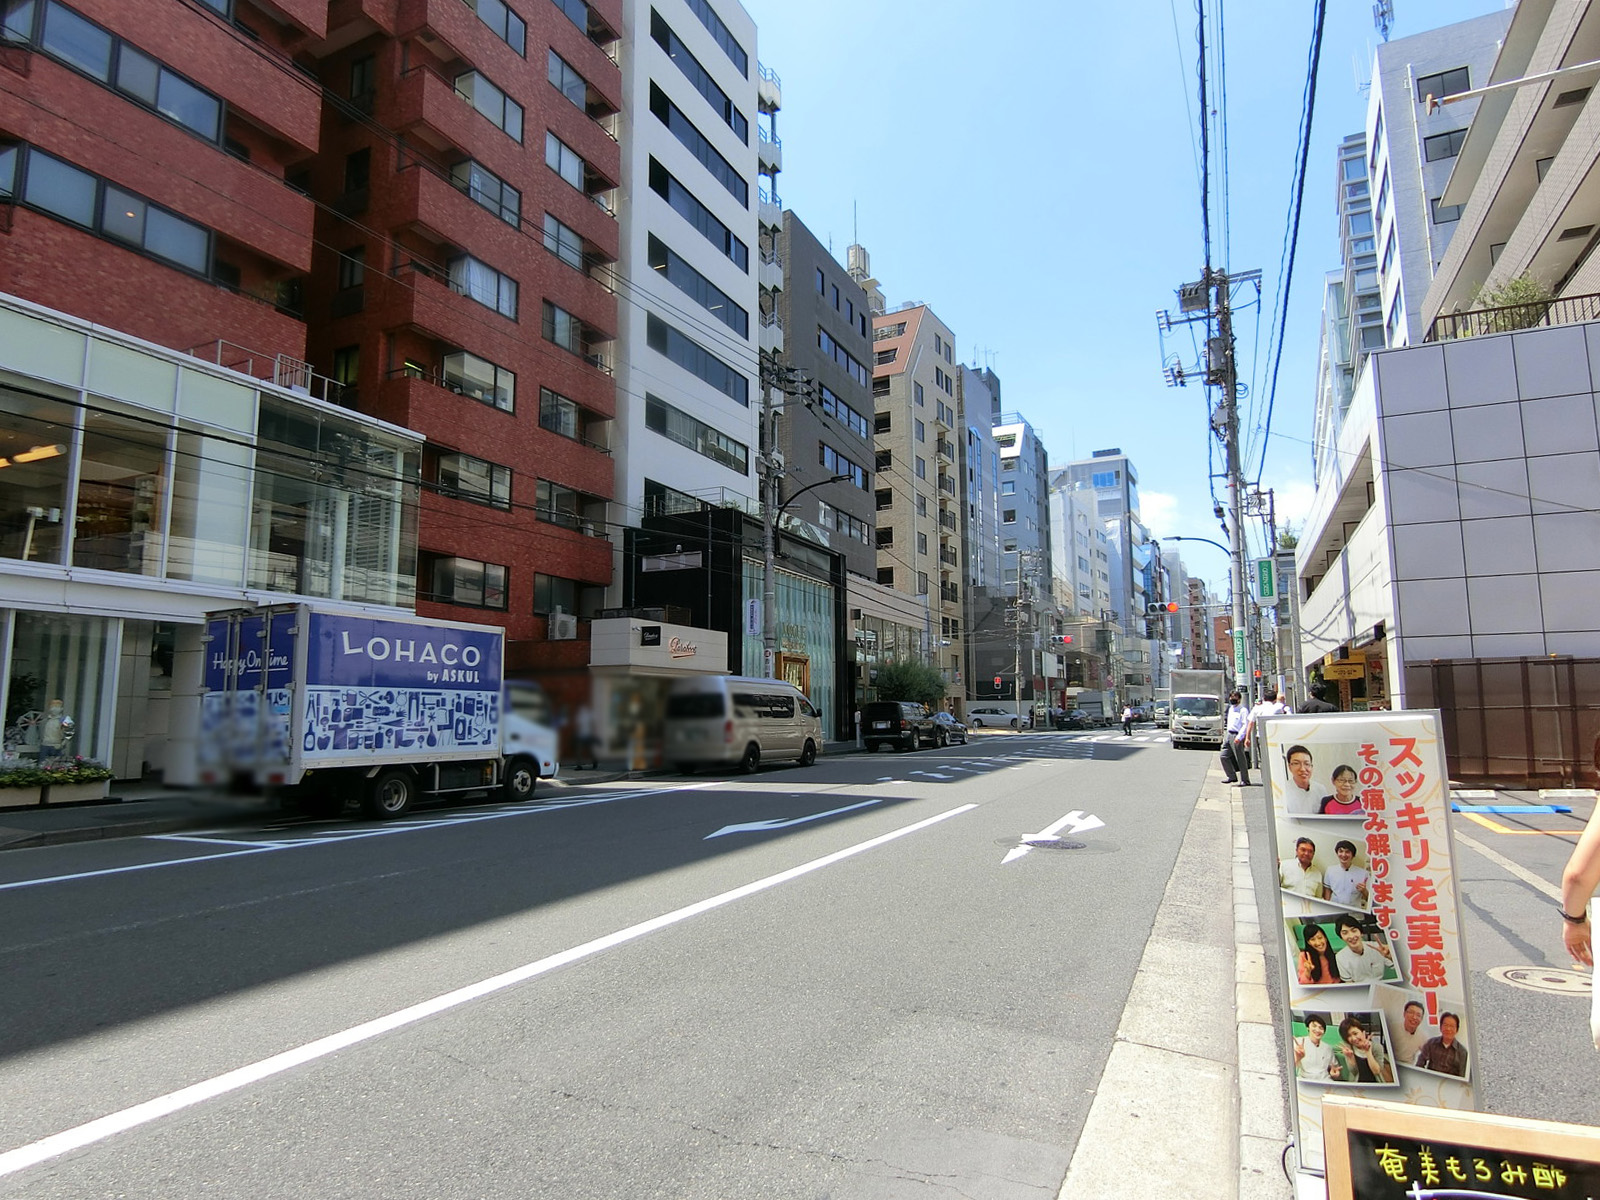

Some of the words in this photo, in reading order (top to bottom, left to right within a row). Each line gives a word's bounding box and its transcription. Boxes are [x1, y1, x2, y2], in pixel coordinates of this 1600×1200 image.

[247, 650, 262, 668] On
[342, 631, 481, 667] LOHACO
[427, 670, 439, 683] by
[442, 669, 480, 683] ASKUL
[1357, 743, 1400, 941] その痛み解ります。
[1374, 1142, 1568, 1190] 奄美もろみ酢
